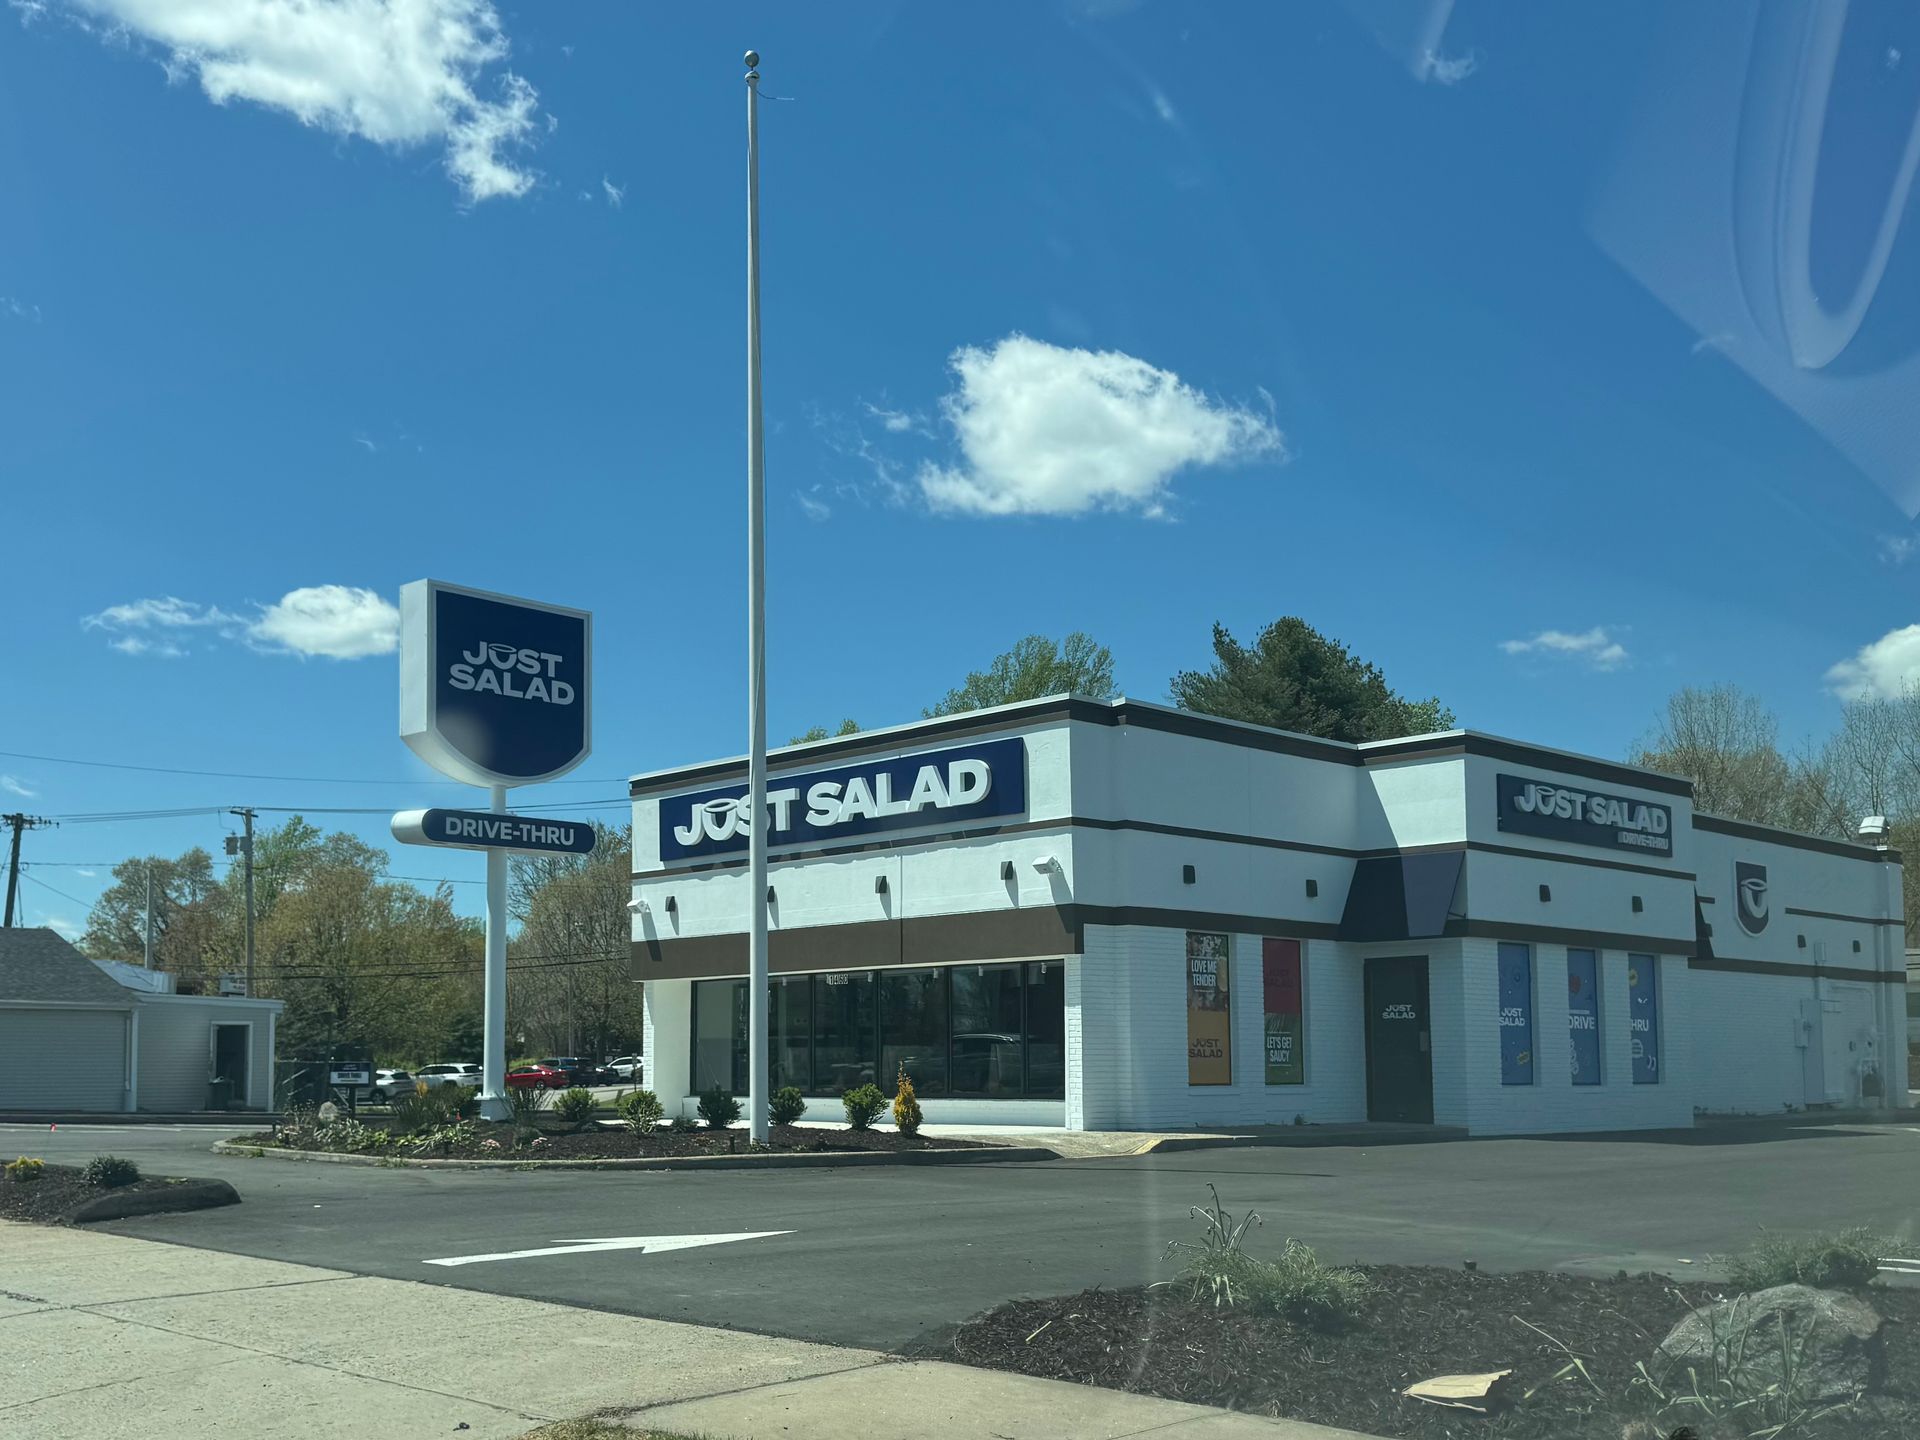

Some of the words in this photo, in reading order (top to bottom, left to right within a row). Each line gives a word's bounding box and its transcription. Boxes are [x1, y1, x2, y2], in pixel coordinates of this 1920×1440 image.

[463, 641, 562, 678] JUST
[449, 664, 574, 705] SALAD
[674, 788, 800, 846] JUST
[806, 758, 992, 826] SALAD
[1514, 784, 1586, 821] JUST
[1586, 796, 1668, 834] SALAD
[445, 817, 575, 846] DRIVE-THRU
[1618, 831, 1669, 850] DRIVE-THRU
[1191, 959, 1206, 973] LOVE
[1207, 960, 1217, 973] ME
[1193, 974, 1216, 987] TENDER
[1501, 1008, 1523, 1017] JUST
[1499, 1017, 1525, 1026] SALAD
[1631, 1018, 1649, 1032] HRU
[1282, 1037, 1292, 1049] GET
[1188, 1048, 1223, 1058] SALAD
